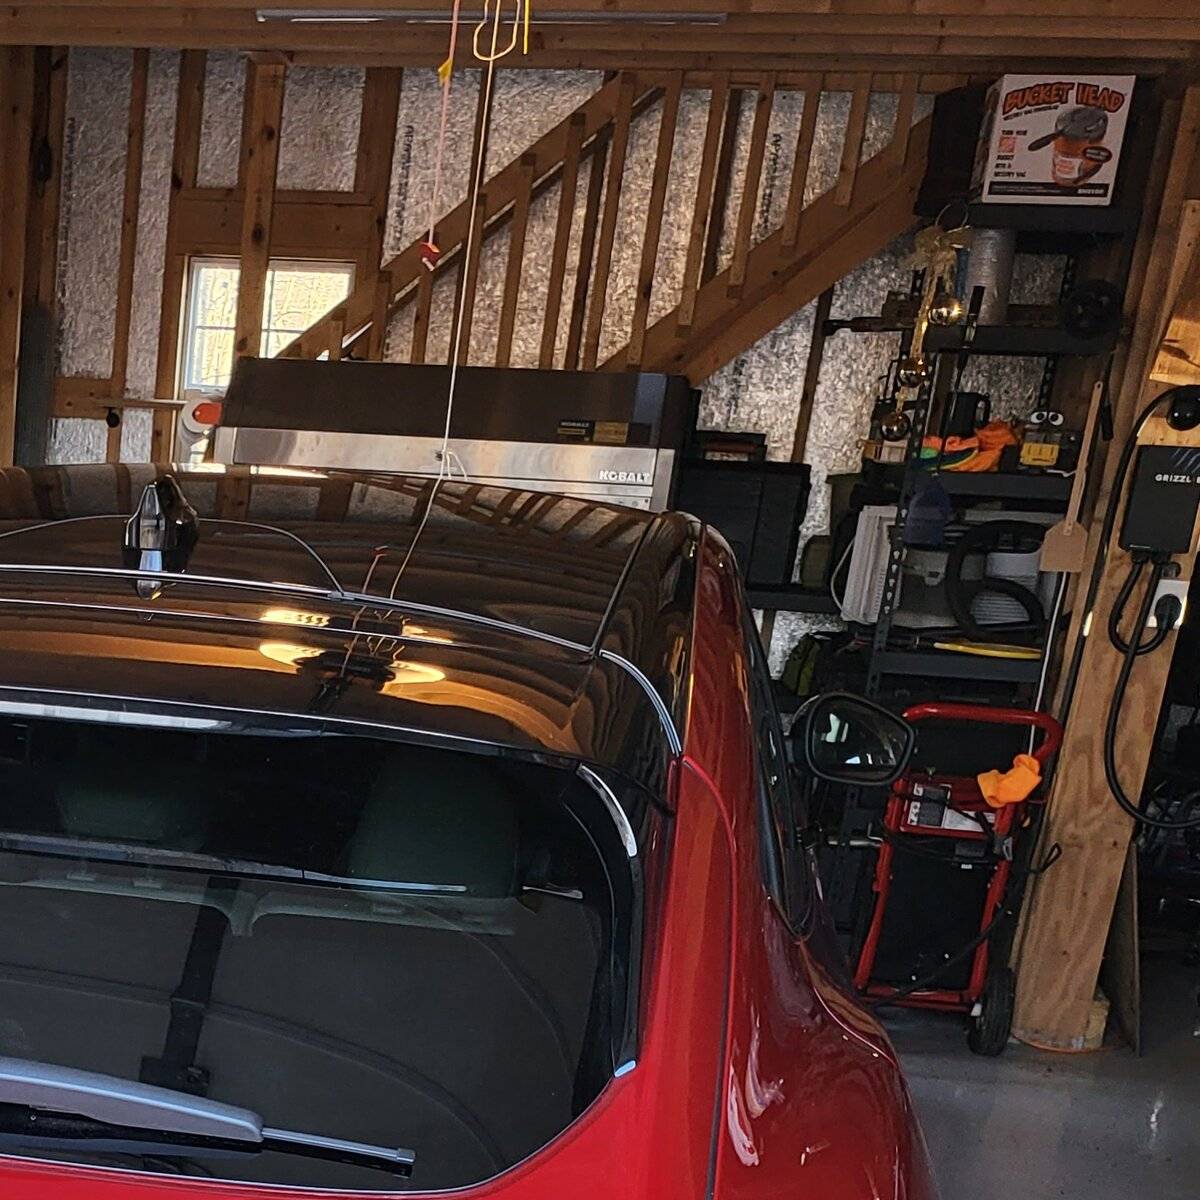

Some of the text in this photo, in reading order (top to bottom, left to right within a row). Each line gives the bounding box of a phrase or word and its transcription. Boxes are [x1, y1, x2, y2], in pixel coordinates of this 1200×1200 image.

[1003, 82, 1074, 115] BUCKET
[1076, 82, 1125, 113] HEAD
[600, 470, 650, 482] KOBALT
